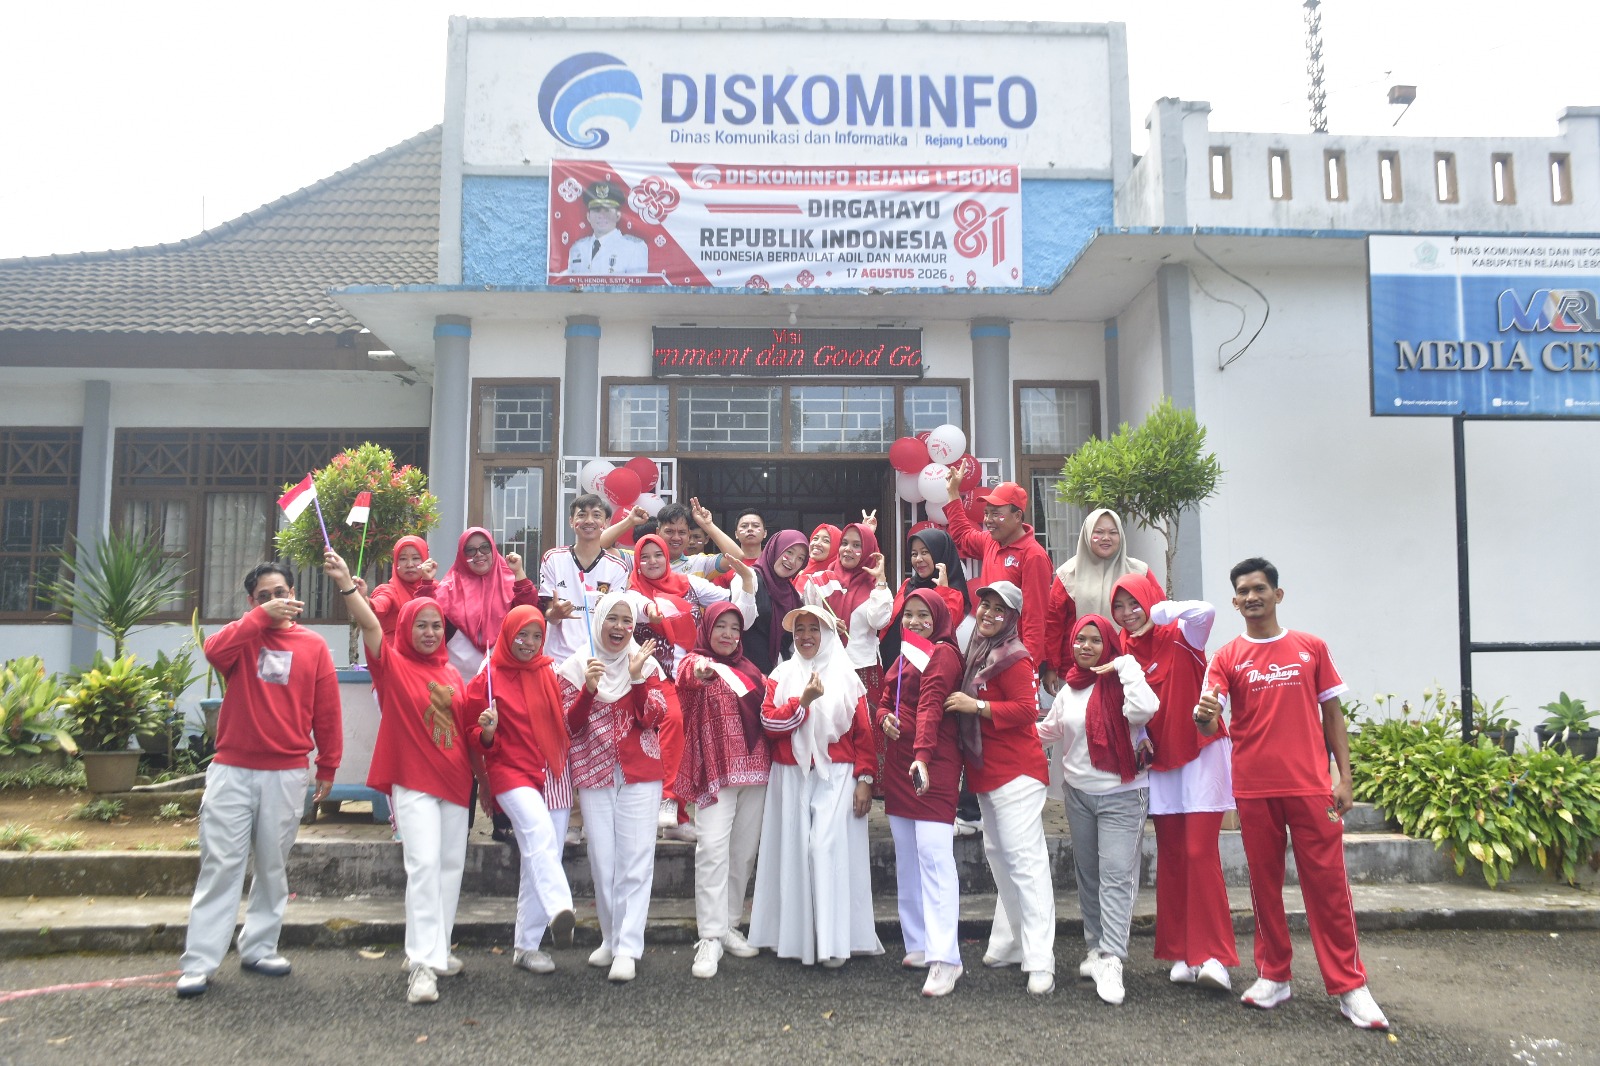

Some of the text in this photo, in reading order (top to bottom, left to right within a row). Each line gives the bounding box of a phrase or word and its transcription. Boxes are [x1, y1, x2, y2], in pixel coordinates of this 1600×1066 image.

[661, 74, 1037, 129] DISKOMINFO
[670, 130, 1008, 149] Dinas Komunikasi dan Informatika Rejang Lebong
[725, 168, 1012, 187] DISKOMINFO REJANG LEBONG
[808, 199, 940, 219] DIRGAHAYU
[700, 229, 948, 250] REPUBLIK INDONESIA
[700, 251, 948, 264] INDONESIA BERDAULAT ADIL DAN MAKMUR
[1450, 247, 1480, 256] DINAS
[1483, 247, 1546, 256] KOMUNIKASI
[1549, 248, 1570, 256] DAN
[1472, 259, 1531, 268] KABUPATEN
[1534, 259, 1575, 269] REJANG
[847, 268, 948, 280] 17 AGUSTUS 2026
[773, 329, 801, 344] Visi
[755, 344, 804, 366] dan
[813, 344, 884, 366] Good
[1395, 340, 1600, 372] MEDIA CE
